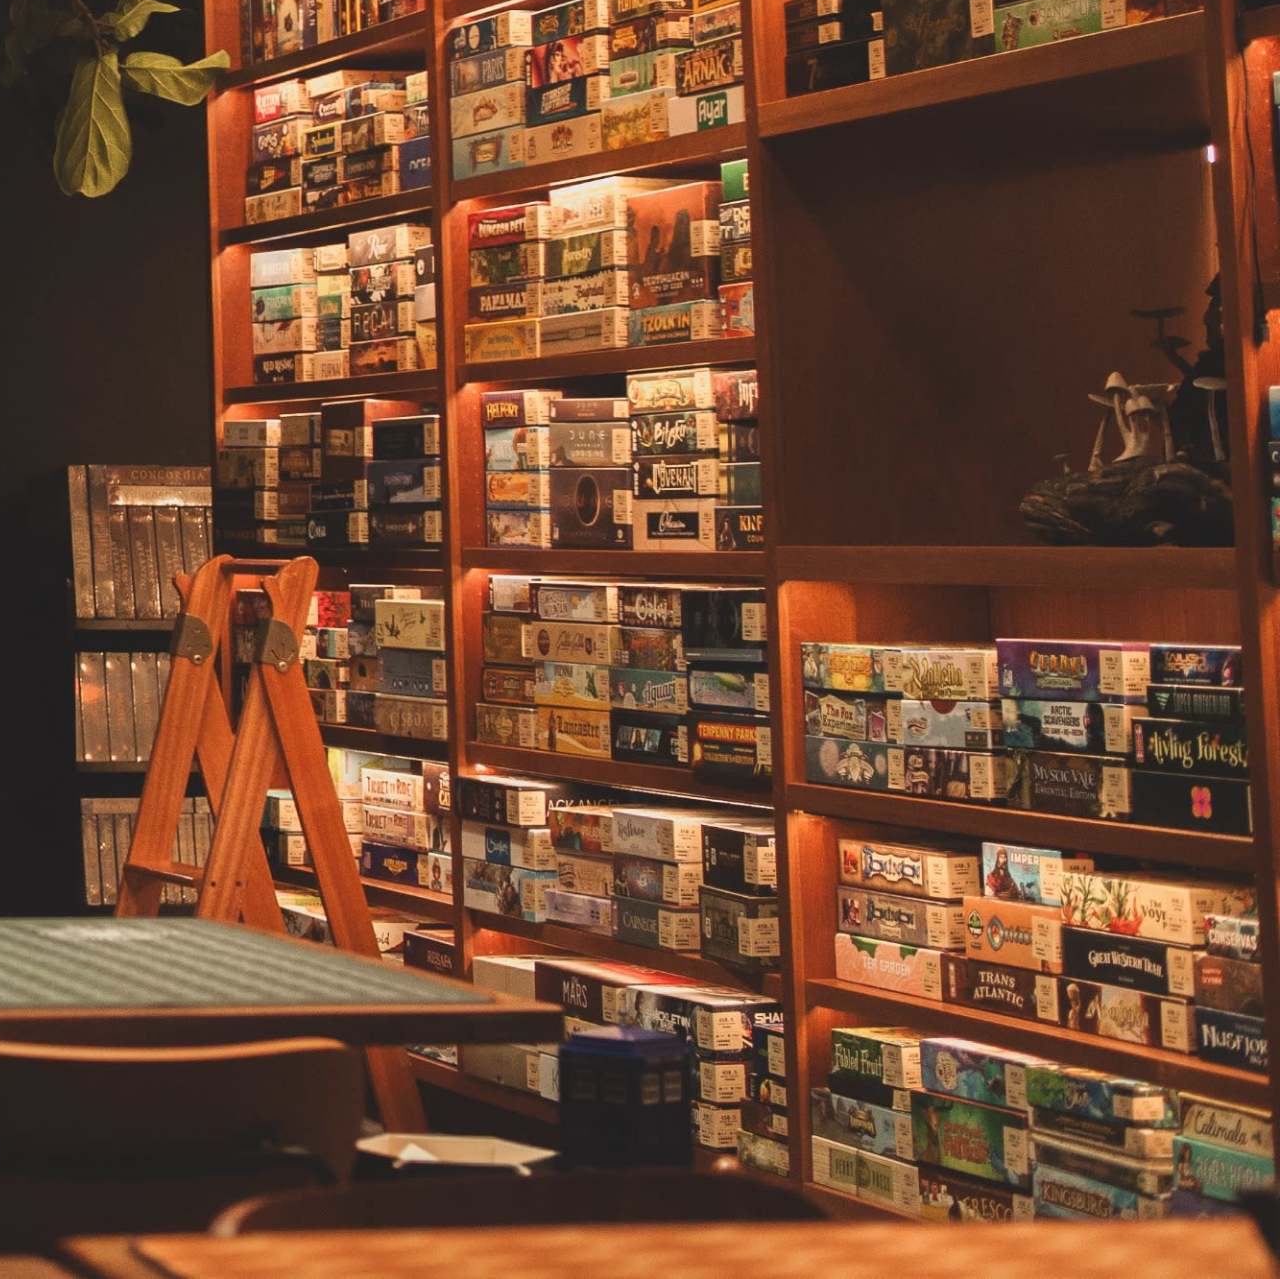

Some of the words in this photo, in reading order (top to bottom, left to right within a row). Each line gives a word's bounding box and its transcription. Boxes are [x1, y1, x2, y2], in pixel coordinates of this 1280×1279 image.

[685, 54, 728, 89] ARNAK
[698, 99, 726, 125] Ayar
[478, 222, 510, 239] DUNGEON
[485, 401, 519, 420] BELFORT
[130, 469, 206, 481] CONCORDIA
[825, 704, 840, 717] The
[840, 706, 853, 721] Fox
[1042, 714, 1081, 728] SCAVENGERS
[1050, 705, 1073, 717] ARCTIC
[698, 724, 733, 739] TENPENNY
[734, 727, 758, 742] PARKS
[822, 713, 864, 733] Experiment
[367, 776, 389, 795] TICKET
[397, 781, 413, 800] RIDE
[365, 810, 387, 825] TICKET
[394, 814, 410, 829] RIDE
[1207, 929, 1258, 951] CONSERVAS
[1087, 949, 1112, 968] GREAT
[1112, 950, 1144, 972] WESTERN
[1144, 957, 1163, 979] TRAIL
[978, 970, 1017, 989] TRANS
[562, 978, 588, 1010] MARS
[972, 987, 1024, 1008] ATLANTIC
[834, 1043, 860, 1071] Fabled
[860, 1050, 882, 1077] Fruit
[1194, 1108, 1248, 1144] Calimala
[963, 1196, 1013, 1218] FRESCO
